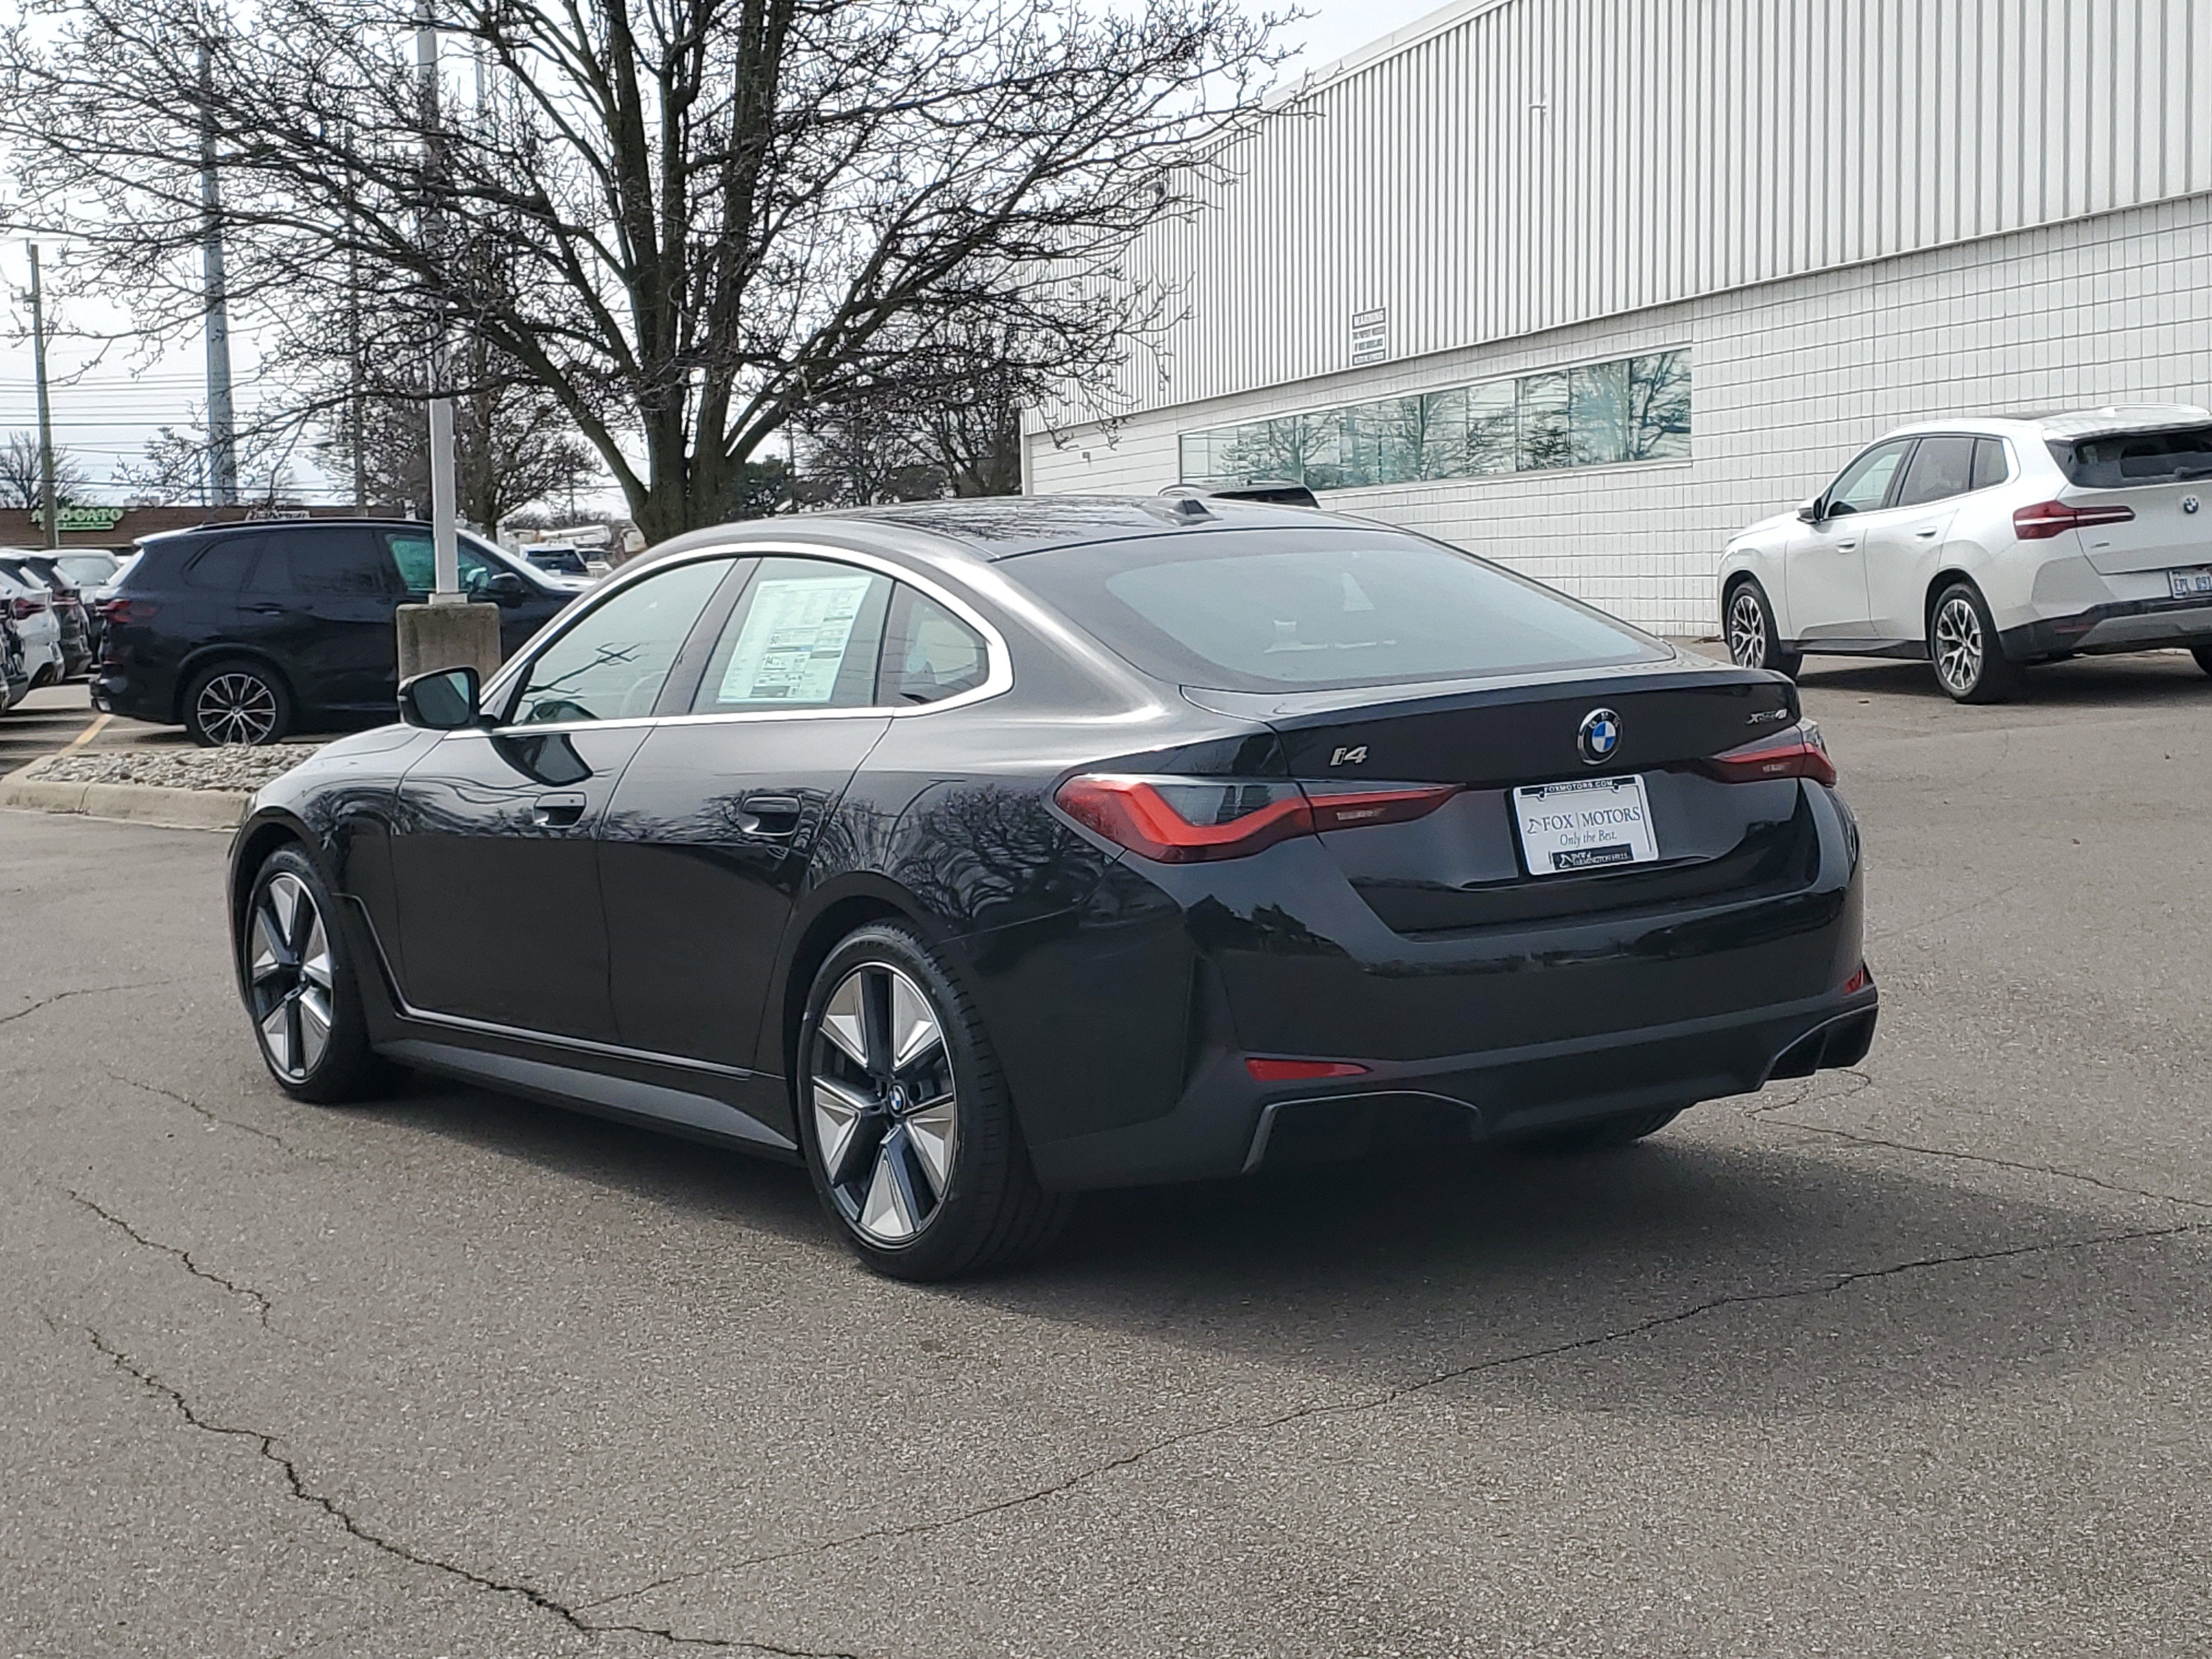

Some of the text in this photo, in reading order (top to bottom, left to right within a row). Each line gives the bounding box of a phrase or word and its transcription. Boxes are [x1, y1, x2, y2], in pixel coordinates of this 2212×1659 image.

[31, 508, 123, 522] AOCATO
[1330, 746, 1368, 766] i4
[1542, 807, 1641, 831] FOX MOTORS
[1560, 832, 1581, 848] Only
[1583, 830, 1595, 844] the
